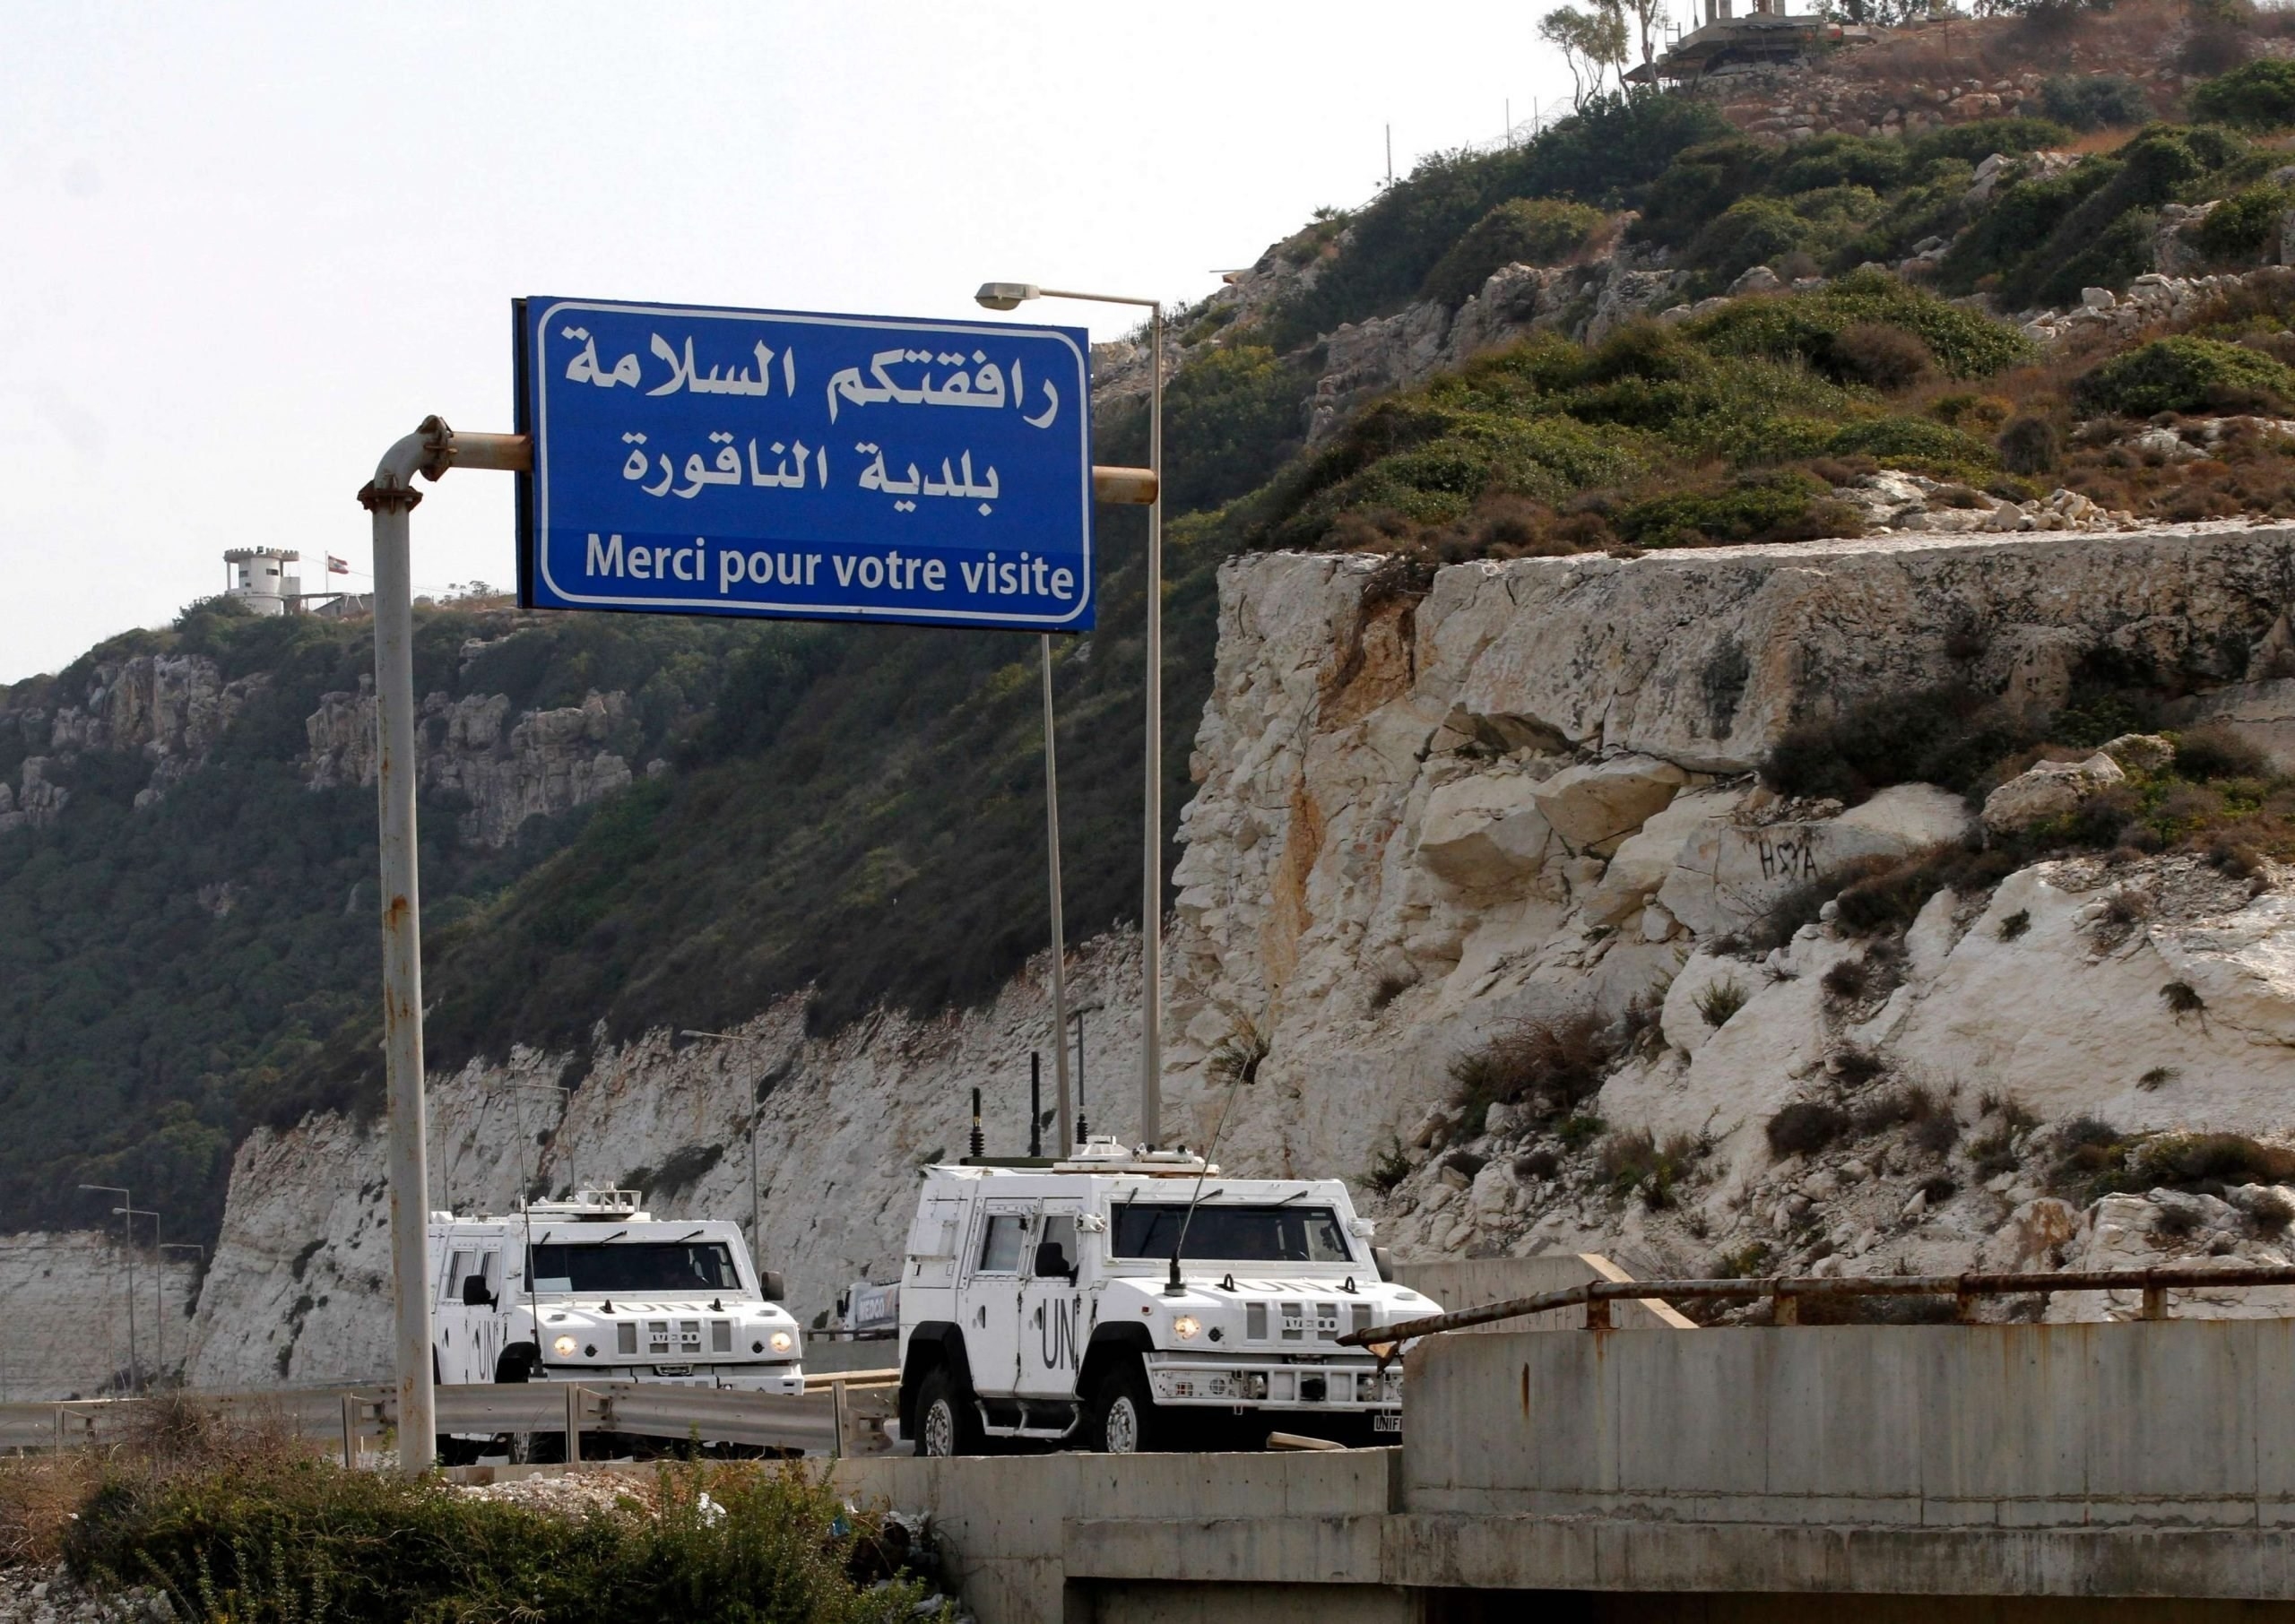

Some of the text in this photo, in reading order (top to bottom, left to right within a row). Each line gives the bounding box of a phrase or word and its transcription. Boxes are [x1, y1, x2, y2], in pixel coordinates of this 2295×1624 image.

[561, 325, 1059, 429] رافقتكم السلامة
[622, 432, 1000, 516] بلدية الناقورة
[585, 533, 1075, 600] Merci pour votre visite
[616, 1303, 700, 1312] UN
[1233, 1281, 1334, 1293] UN
[478, 1320, 497, 1381] UN
[1043, 1299, 1076, 1369] UN
[1281, 1316, 1340, 1332] IVECO
